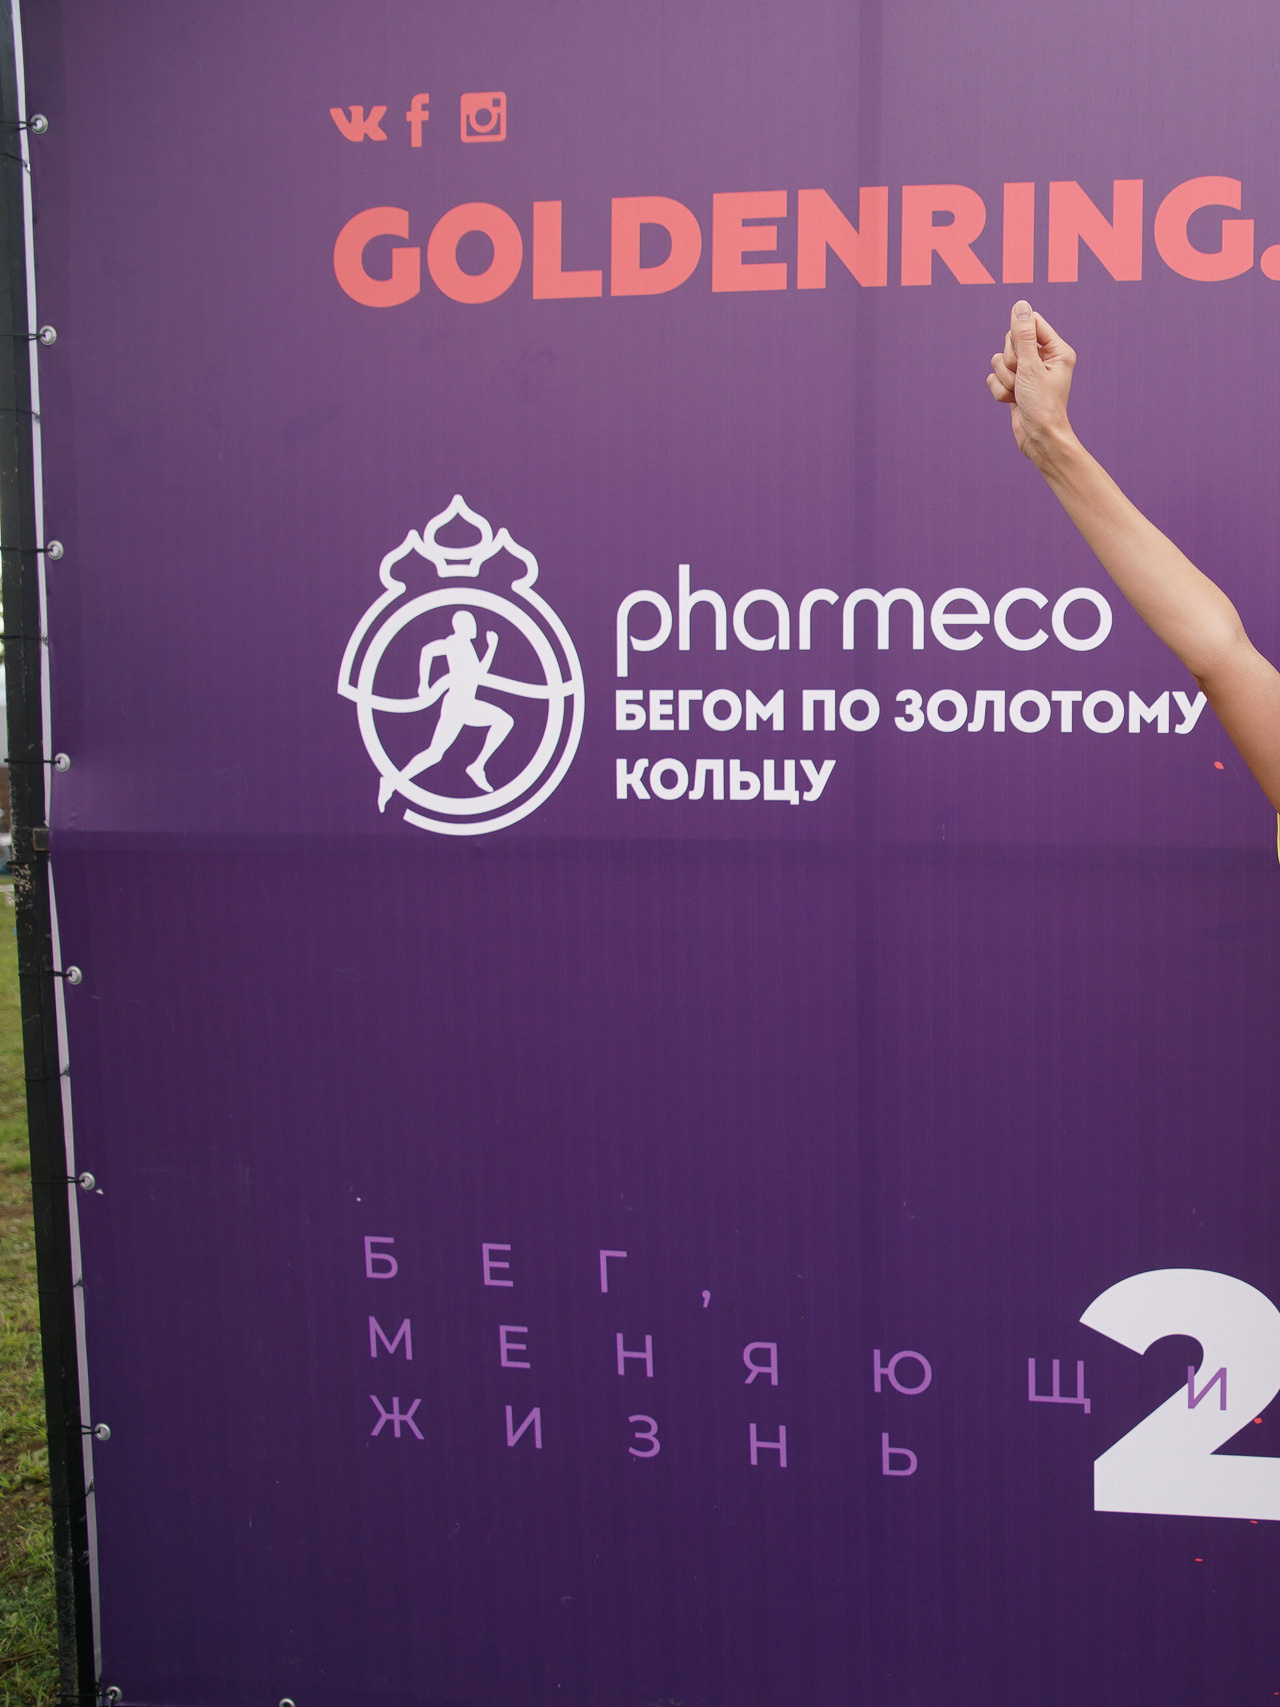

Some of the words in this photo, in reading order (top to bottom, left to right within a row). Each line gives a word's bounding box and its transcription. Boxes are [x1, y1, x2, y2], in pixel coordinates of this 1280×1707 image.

[616, 563, 1113, 678] pharmeco
[615, 688, 786, 733] БЕГОМ
[802, 688, 881, 733] ПО
[893, 688, 1208, 735] ЗОЛОТОМУ
[616, 757, 837, 806] КОЛЬЦУ
[368, 1316, 1229, 1414] МЕНЯЮЩИ
